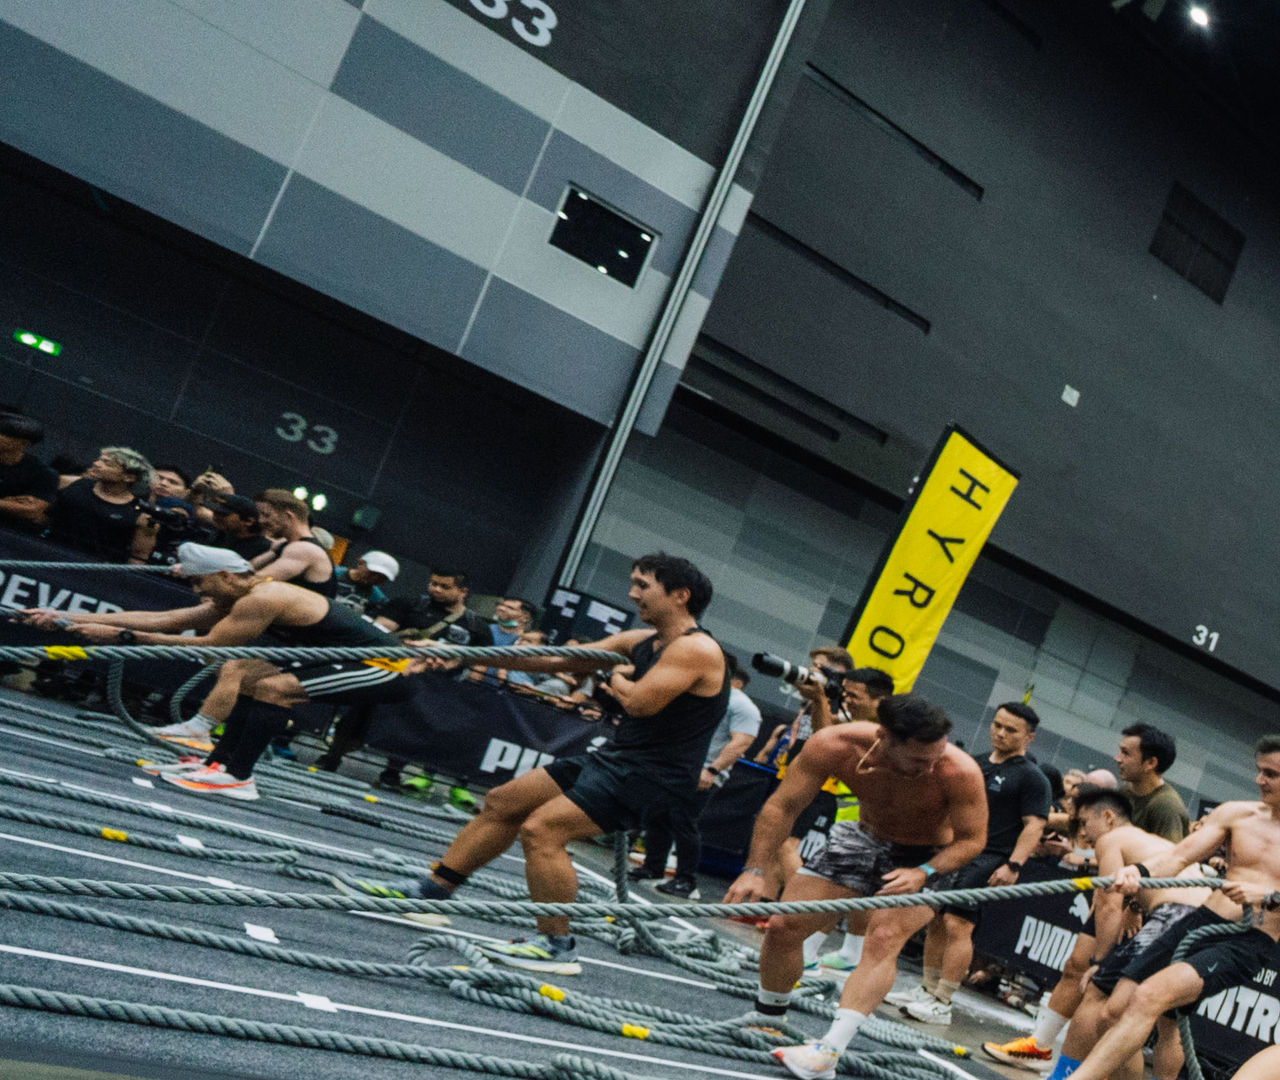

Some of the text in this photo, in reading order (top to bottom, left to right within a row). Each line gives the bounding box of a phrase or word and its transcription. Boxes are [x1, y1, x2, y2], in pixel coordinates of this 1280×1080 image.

[275, 412, 339, 455] 33
[1192, 624, 1220, 652] 31
[1263, 968, 1278, 987] BY
